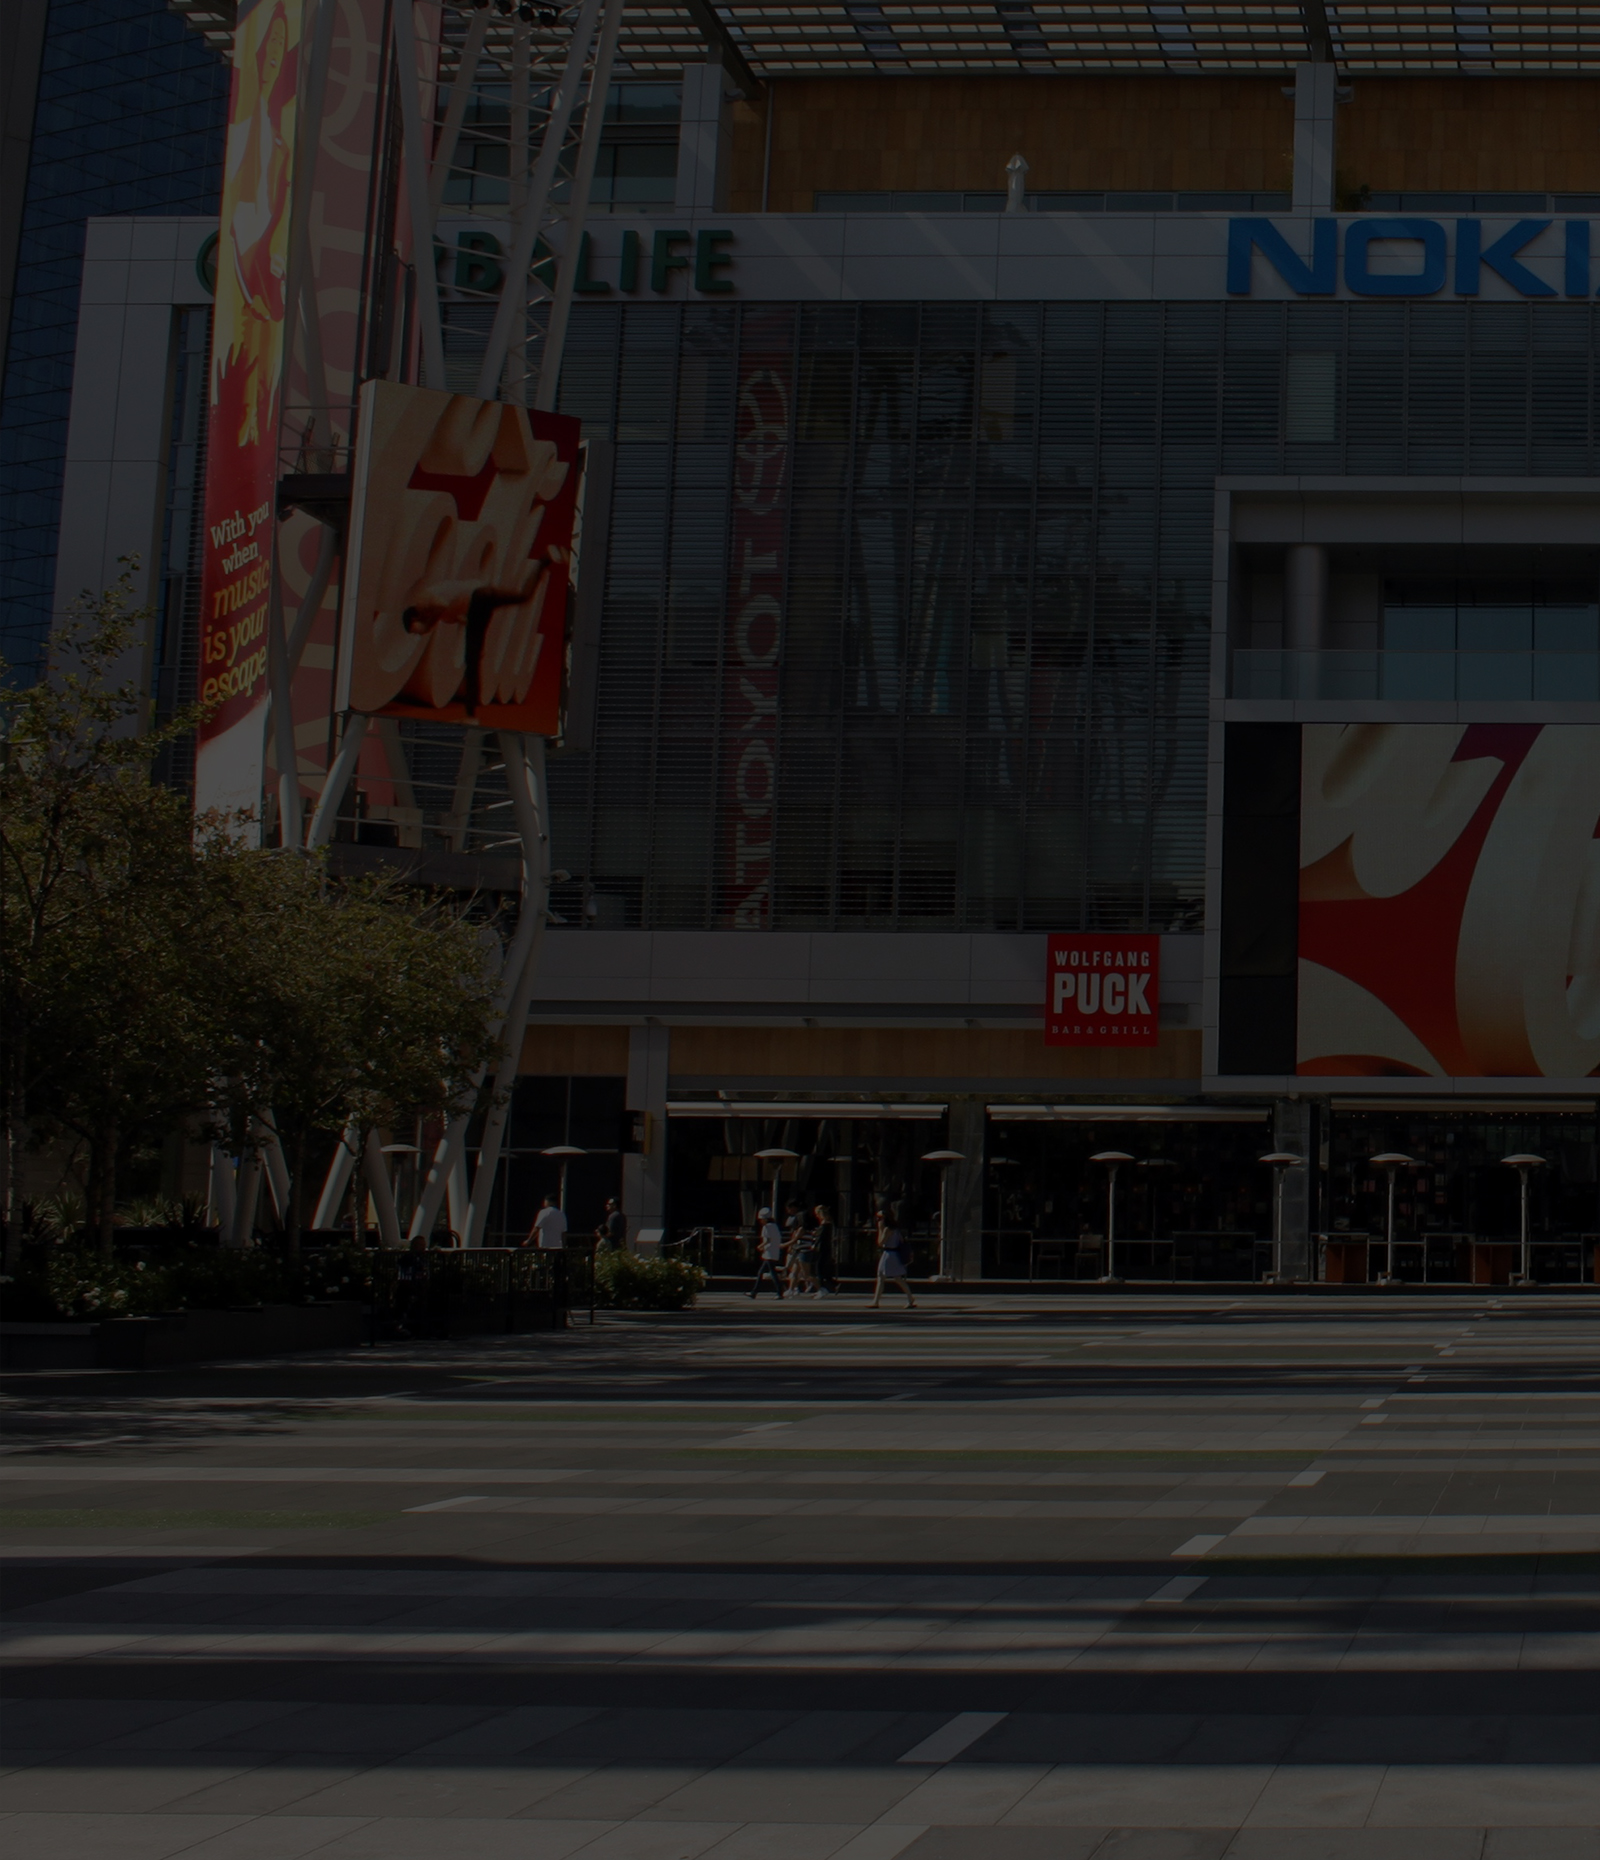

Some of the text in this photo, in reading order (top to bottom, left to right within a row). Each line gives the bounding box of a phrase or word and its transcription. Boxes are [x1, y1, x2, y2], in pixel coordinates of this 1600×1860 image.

[210, 501, 270, 549] With you
[222, 541, 259, 575] when
[213, 555, 270, 619] music
[204, 602, 268, 667] is your
[202, 645, 267, 706] escape
[1054, 950, 1150, 967] WOLFGANG
[1053, 972, 1152, 1015] PUCK
